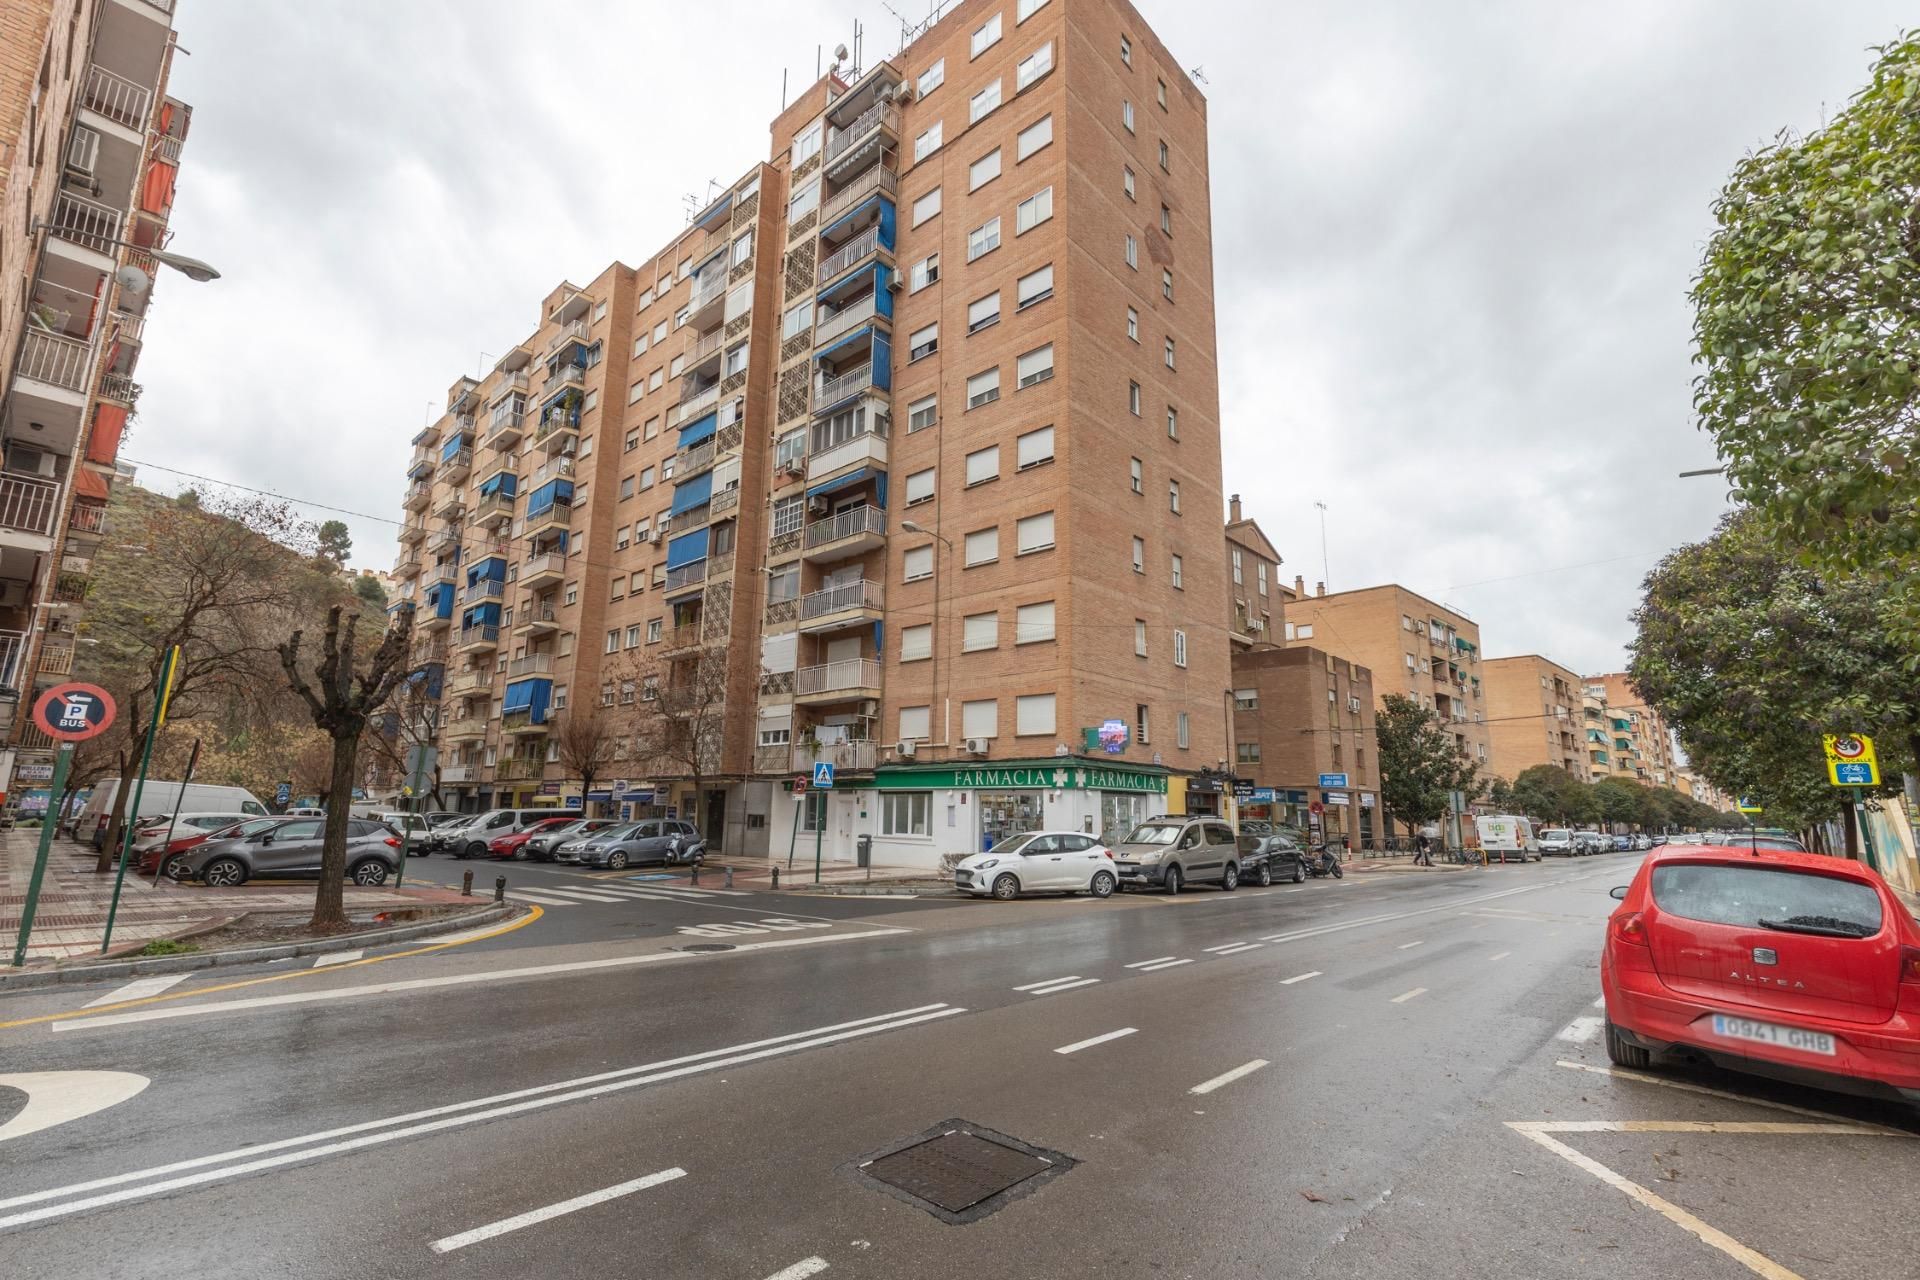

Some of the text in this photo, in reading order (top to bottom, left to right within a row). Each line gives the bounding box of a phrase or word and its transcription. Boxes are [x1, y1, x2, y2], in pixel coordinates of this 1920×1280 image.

[70, 706, 82, 716] P
[60, 718, 86, 728] BUS
[954, 770, 1046, 786] FARMACIA
[1091, 770, 1156, 789] FARMACIA
[1730, 971, 1805, 989] ALTEA
[1727, 1019, 1830, 1052] 0941 GHB
